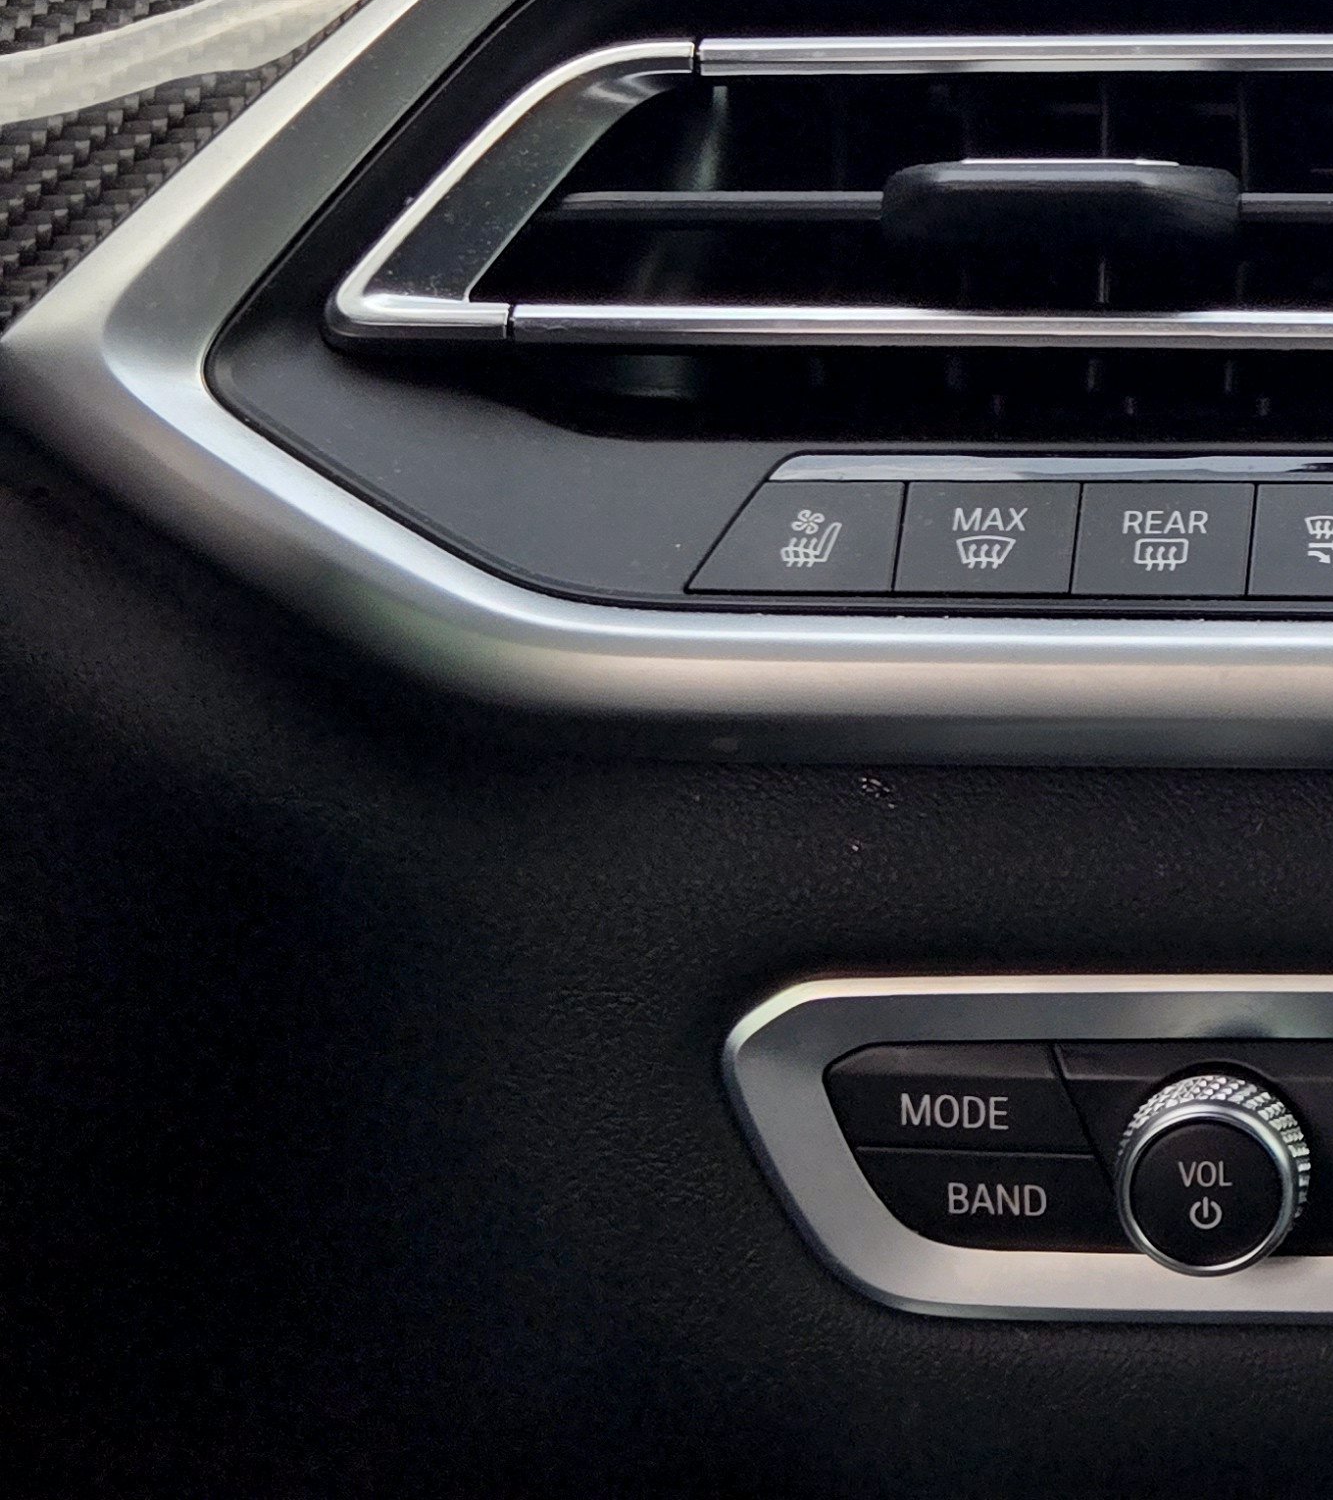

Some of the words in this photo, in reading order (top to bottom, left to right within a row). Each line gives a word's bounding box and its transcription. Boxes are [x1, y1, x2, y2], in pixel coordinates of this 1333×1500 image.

[952, 507, 1027, 532] MAX
[1122, 510, 1208, 535] REAR
[901, 1094, 1009, 1131] MODE
[1178, 1161, 1232, 1188] VOL
[947, 1182, 1047, 1217] BAND
